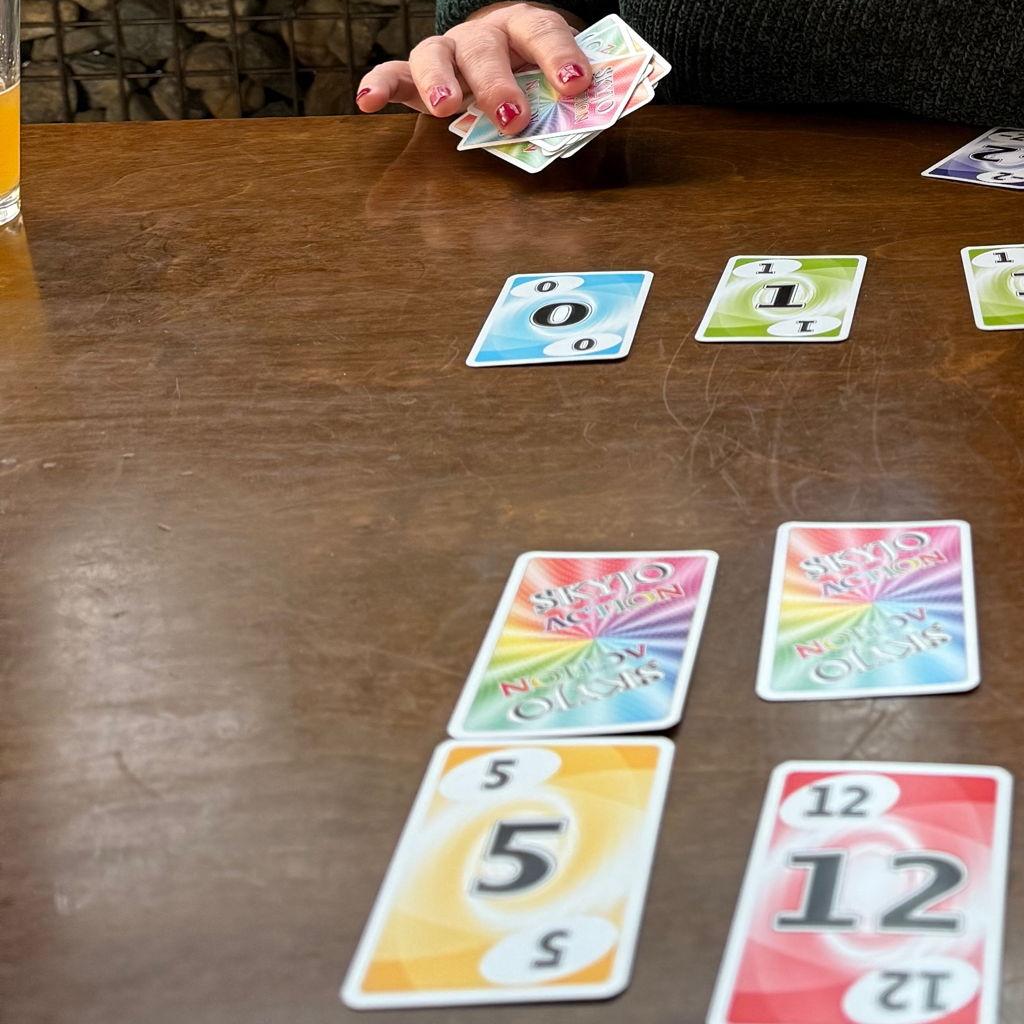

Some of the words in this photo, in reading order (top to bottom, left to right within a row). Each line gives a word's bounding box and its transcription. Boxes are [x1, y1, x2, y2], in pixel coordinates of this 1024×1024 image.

[757, 262, 774, 274] 1
[994, 252, 1014, 263] 1
[534, 280, 558, 293] 0
[754, 282, 807, 310] 1
[529, 298, 593, 329] 0
[798, 321, 816, 333] 1
[572, 337, 597, 352] 0
[800, 530, 932, 582] SKYJO
[820, 548, 949, 600] ACTION
[529, 562, 676, 616] SKYJO
[544, 582, 688, 632] ACTION
[811, 621, 953, 686] SKYJO
[506, 659, 666, 725] SKYJO
[480, 759, 520, 792] 5
[801, 784, 870, 820] 12
[469, 814, 571, 900] 5
[772, 850, 968, 936] 12
[530, 927, 573, 971] 5
[877, 967, 955, 1014] 12
